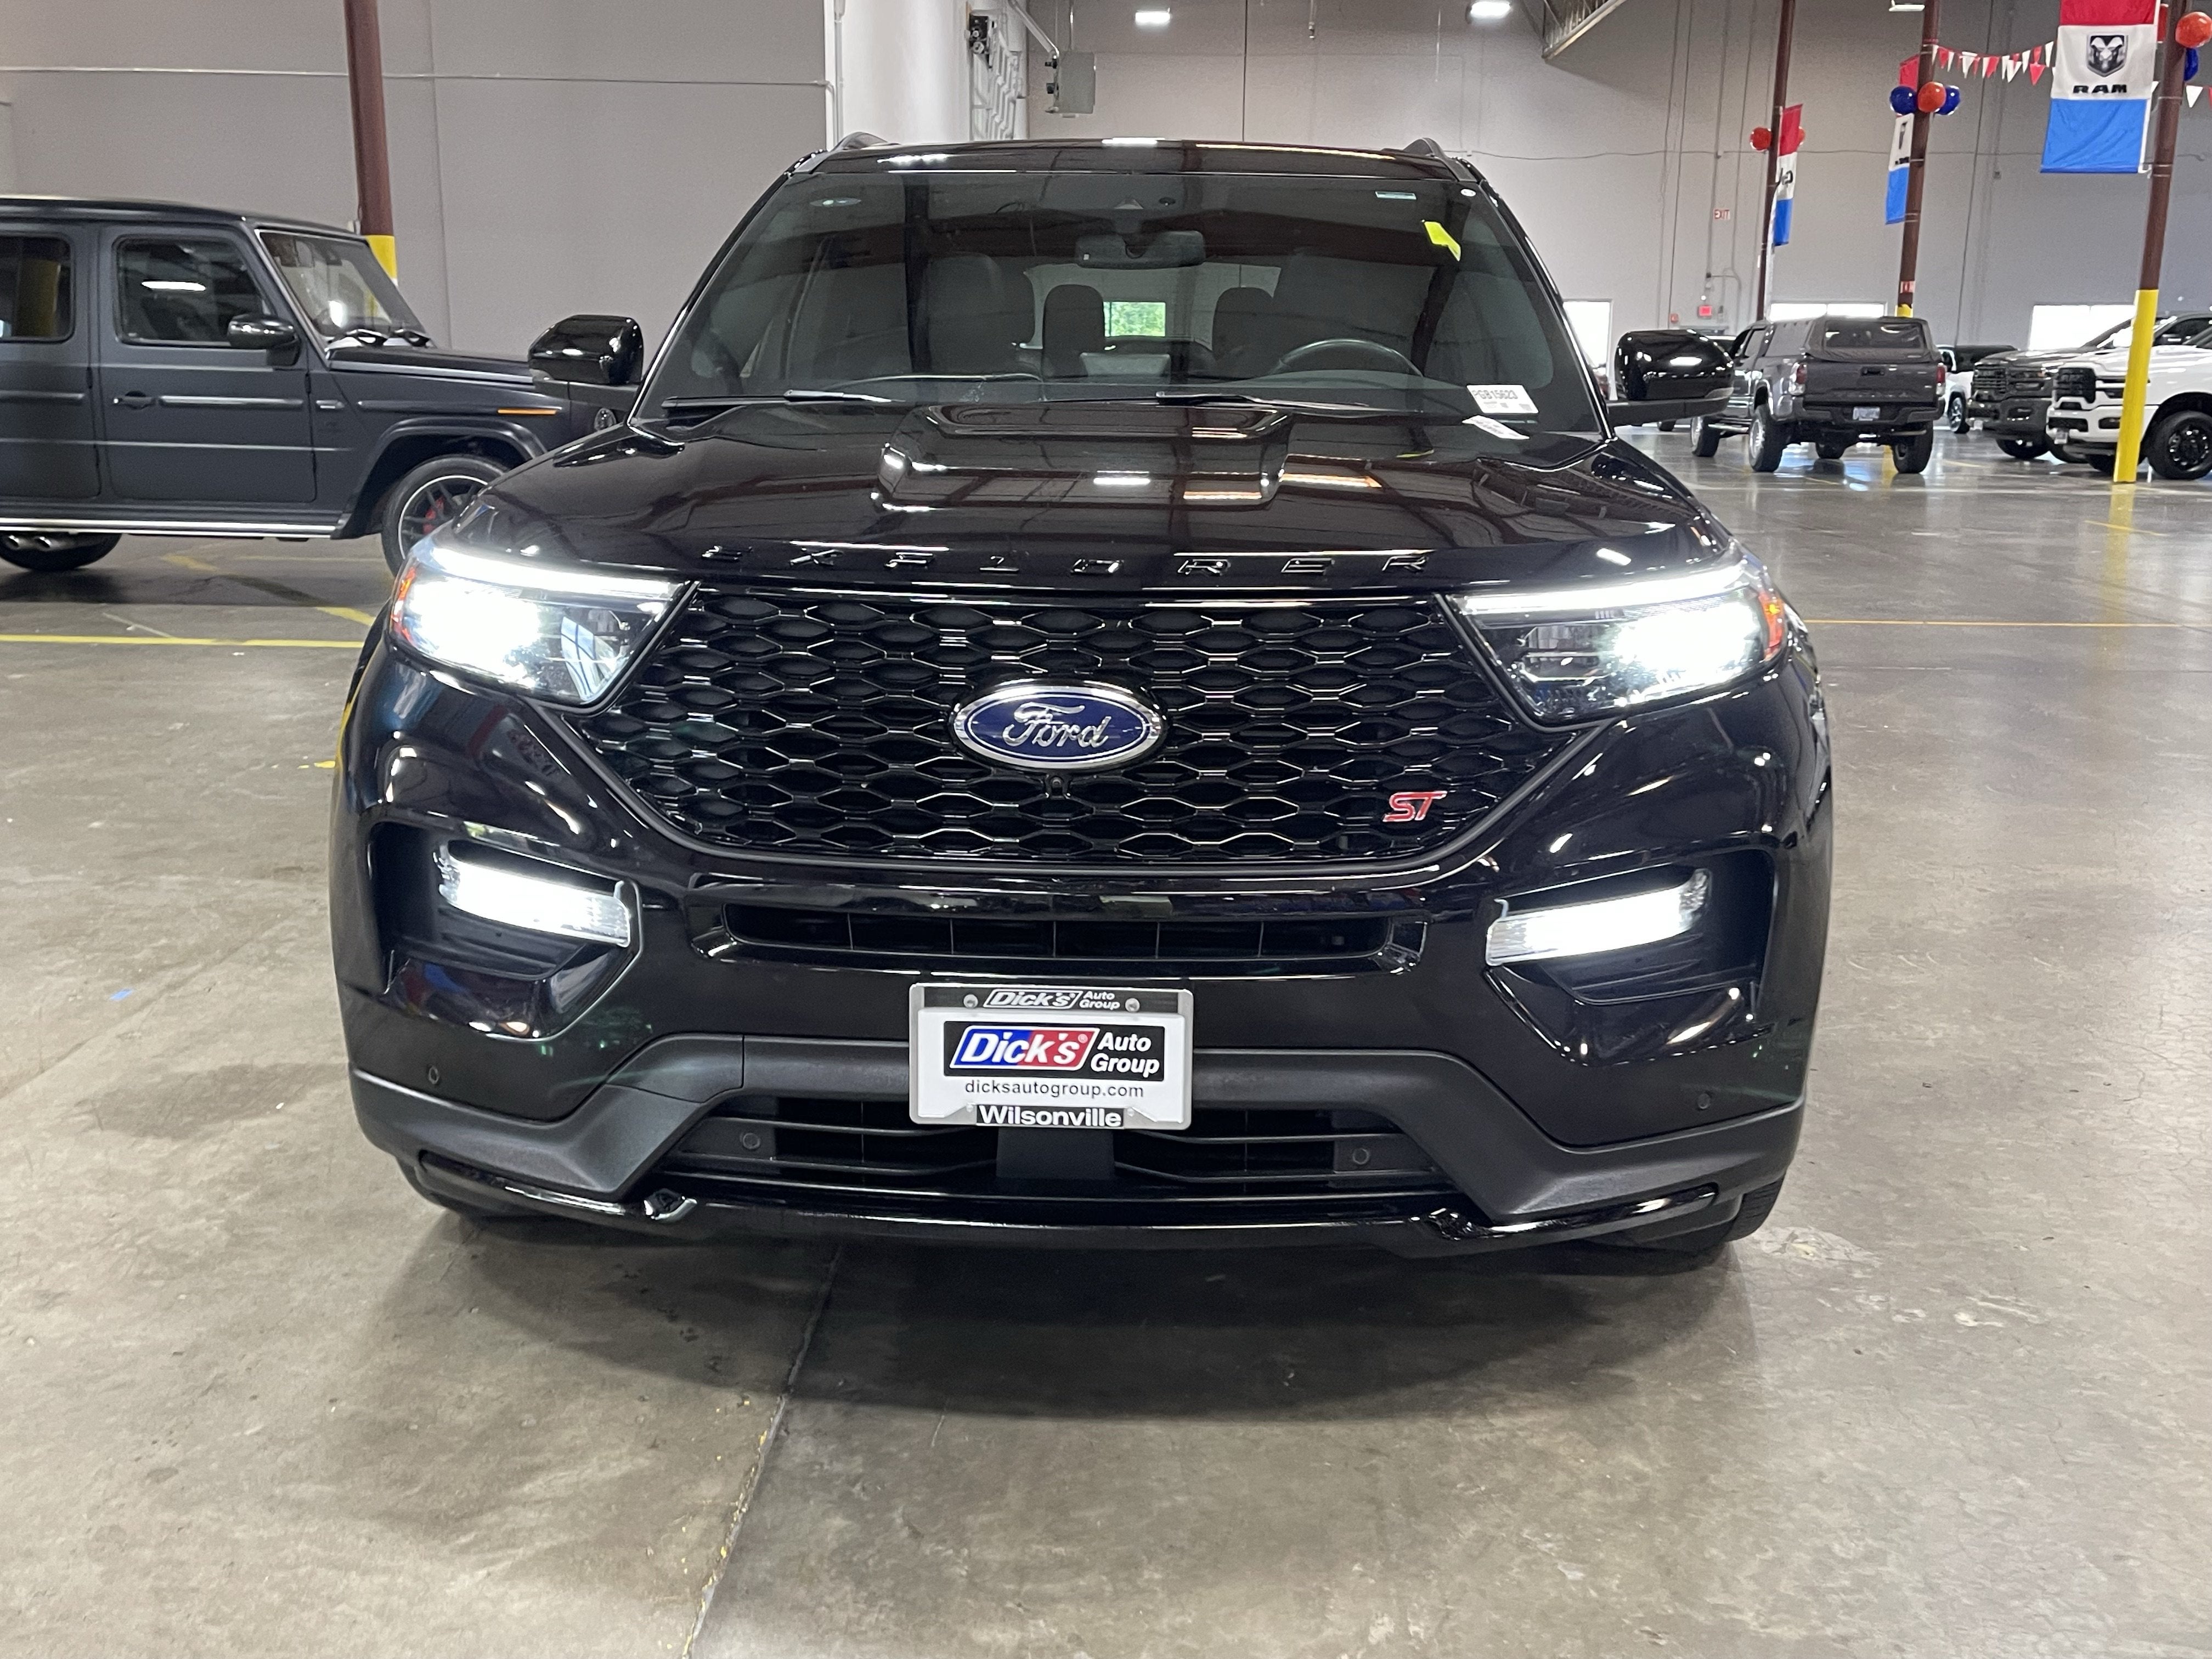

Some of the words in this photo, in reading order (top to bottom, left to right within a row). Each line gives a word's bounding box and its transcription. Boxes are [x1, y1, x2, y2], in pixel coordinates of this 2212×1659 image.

[2073, 84, 2127, 94] RAM
[1002, 701, 1112, 748] Ford
[1382, 790, 1448, 822] ST
[1079, 1000, 1121, 1011] Group
[1082, 990, 1116, 1000] Auto
[960, 1030, 1081, 1065] Dick's
[1097, 1031, 1152, 1052] Auto
[1091, 1053, 1160, 1077] Group
[965, 1080, 1144, 1098] dicksautogroup.com
[978, 1105, 1122, 1127] Wilsonville
